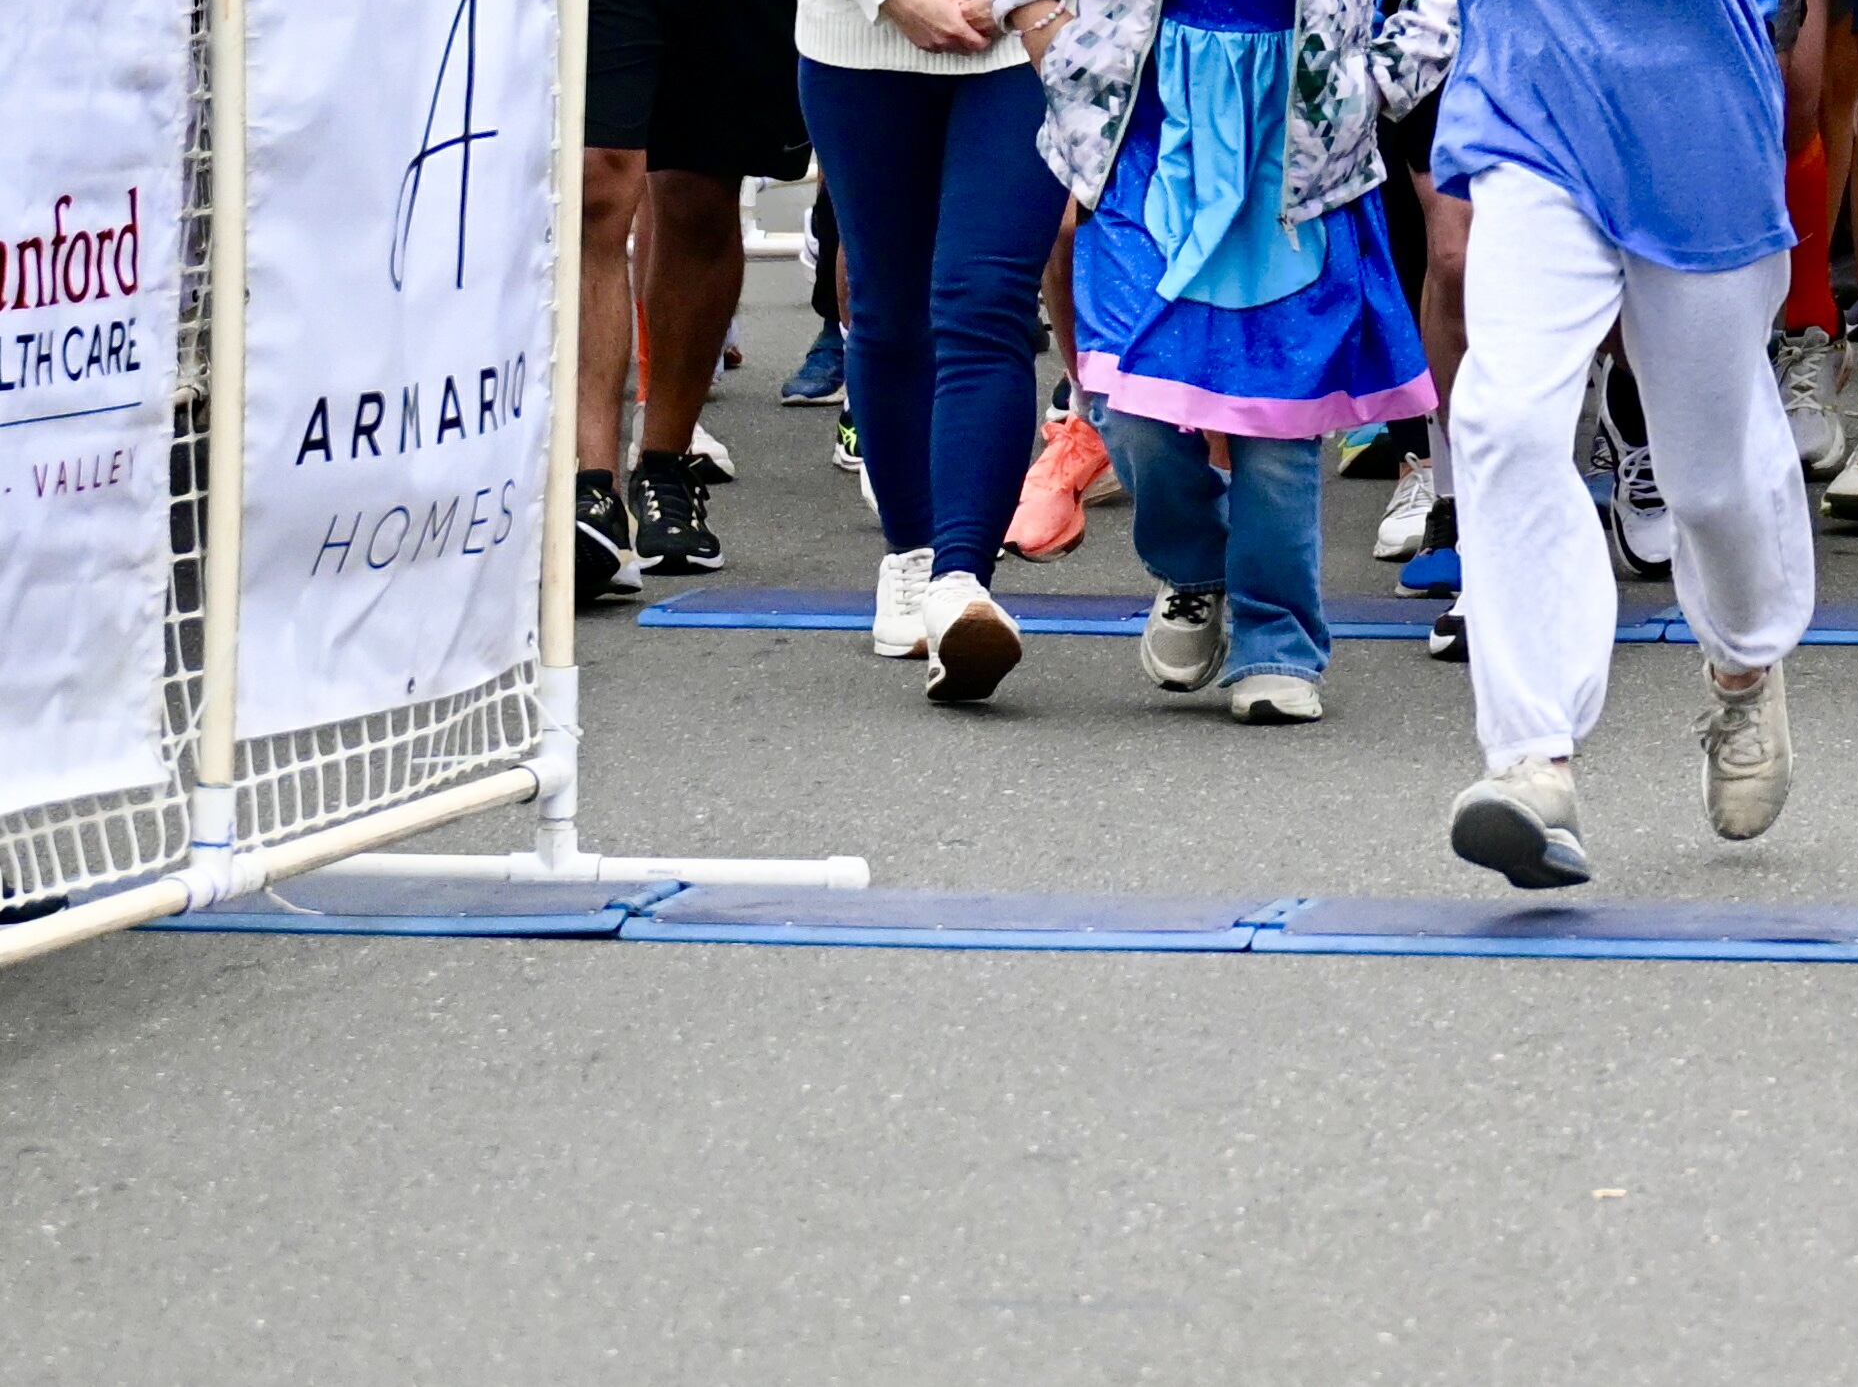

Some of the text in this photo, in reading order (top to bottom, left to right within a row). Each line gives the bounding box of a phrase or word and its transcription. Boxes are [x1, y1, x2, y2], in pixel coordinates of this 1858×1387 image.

[62, 316, 141, 382] CARE
[295, 350, 527, 466] ARMARIO
[33, 445, 137, 498] VALLEY
[310, 478, 516, 577] HOMES
